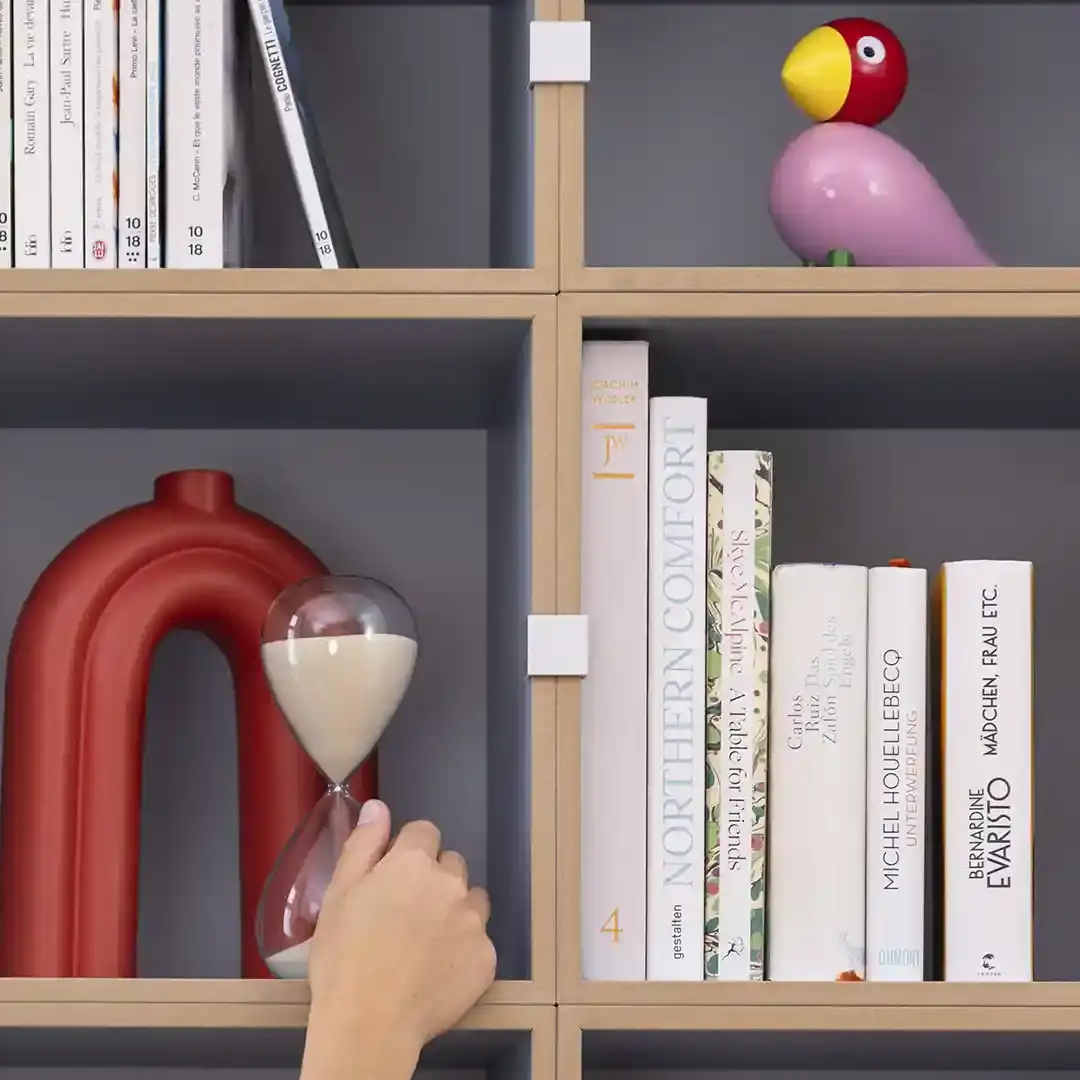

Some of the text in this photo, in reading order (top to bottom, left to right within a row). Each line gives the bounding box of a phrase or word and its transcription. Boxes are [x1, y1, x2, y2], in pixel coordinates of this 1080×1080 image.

[24, 33, 35, 49] vie
[130, 17, 138, 27] La
[24, 52, 35, 67] La
[192, 59, 200, 86] monde
[263, 26, 288, 92] COGNETTI Le
[59, 30, 75, 128] Jean-Paul Sartre
[24, 80, 39, 155] Romain Gary
[193, 121, 202, 137] que
[193, 139, 200, 148] Et
[192, 156, 200, 191] McCann
[126, 217, 140, 229] 10
[126, 236, 140, 247] 18
[189, 226, 204, 237] 10
[315, 230, 328, 242] 10
[189, 245, 204, 256] 18
[319, 244, 332, 256] 18
[725, 529, 749, 675] Skye McAlpine
[661, 416, 696, 888] NORTHERN COMFORT
[821, 648, 839, 688] Spiel
[837, 634, 856, 688] Engels
[980, 583, 999, 756] MÄDCHEN, FRAU ETC.
[804, 656, 820, 688] Das
[787, 694, 803, 750] Carlos
[804, 694, 820, 732] Ruiz
[819, 695, 838, 744] Zafón
[728, 687, 749, 872] A Table for Friends
[883, 649, 902, 891] MICHEL HOUELLEBECQ
[905, 710, 918, 847] UNTERWERFUNG
[969, 788, 985, 879] BERNARDINE
[986, 776, 1012, 889] EVARISTO
[600, 907, 624, 943] 4
[671, 904, 686, 960] gestalten
